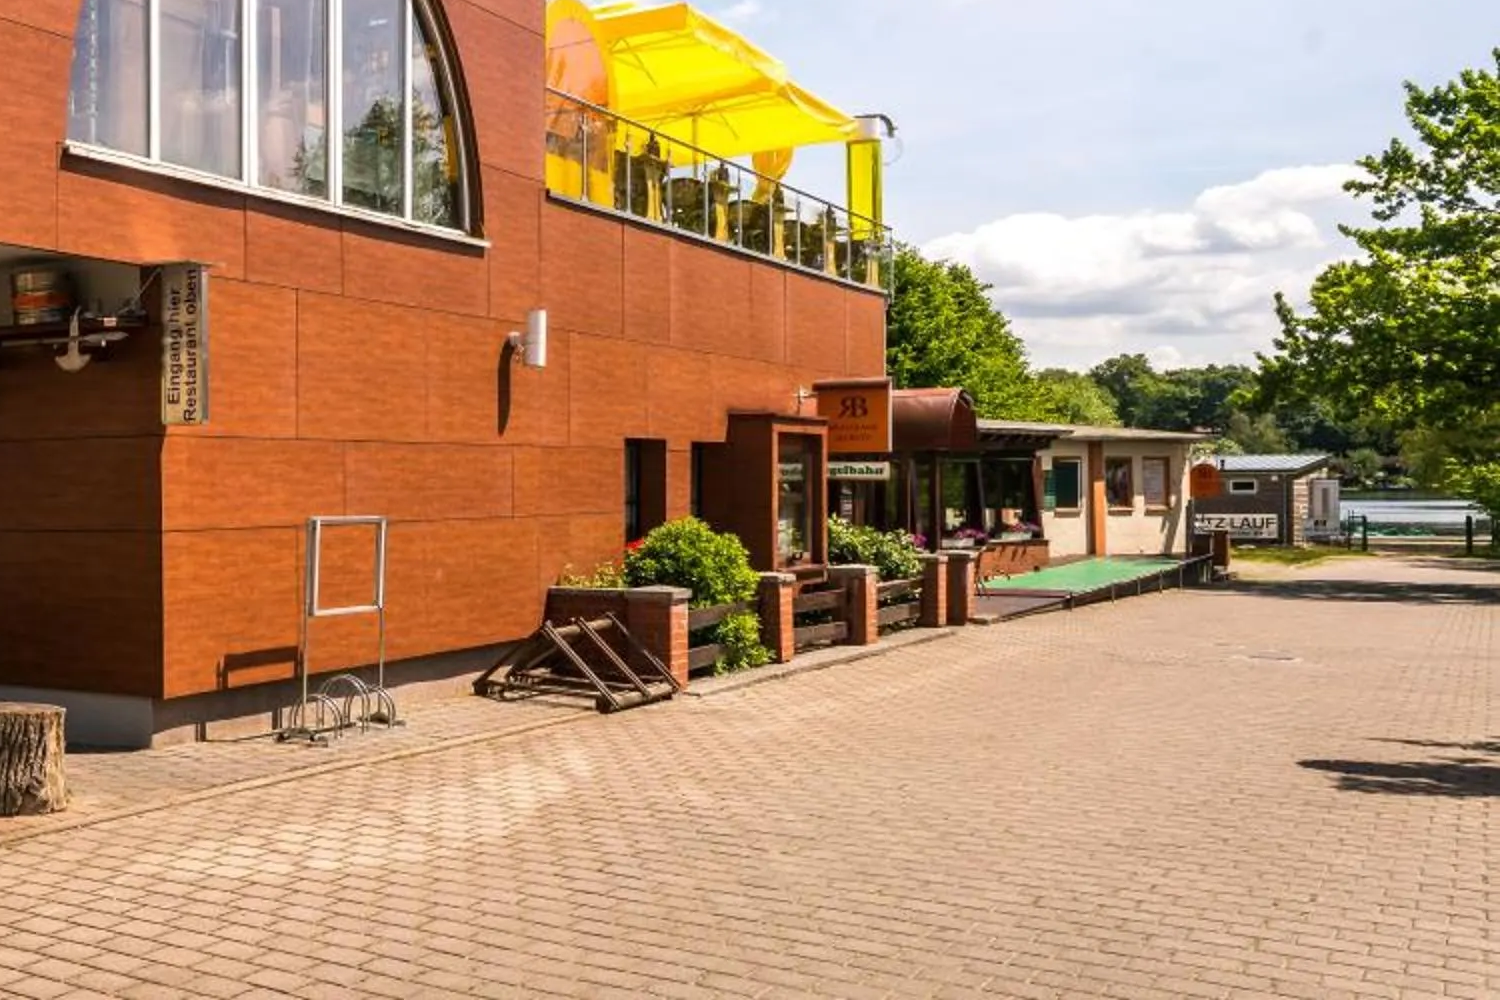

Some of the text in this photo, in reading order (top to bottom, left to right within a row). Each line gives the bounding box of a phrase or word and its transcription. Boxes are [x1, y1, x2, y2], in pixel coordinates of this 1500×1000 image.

[168, 288, 183, 404] Eingang hier
[184, 269, 197, 423] Restaurant oben
[1230, 517, 1277, 529] LAUF
